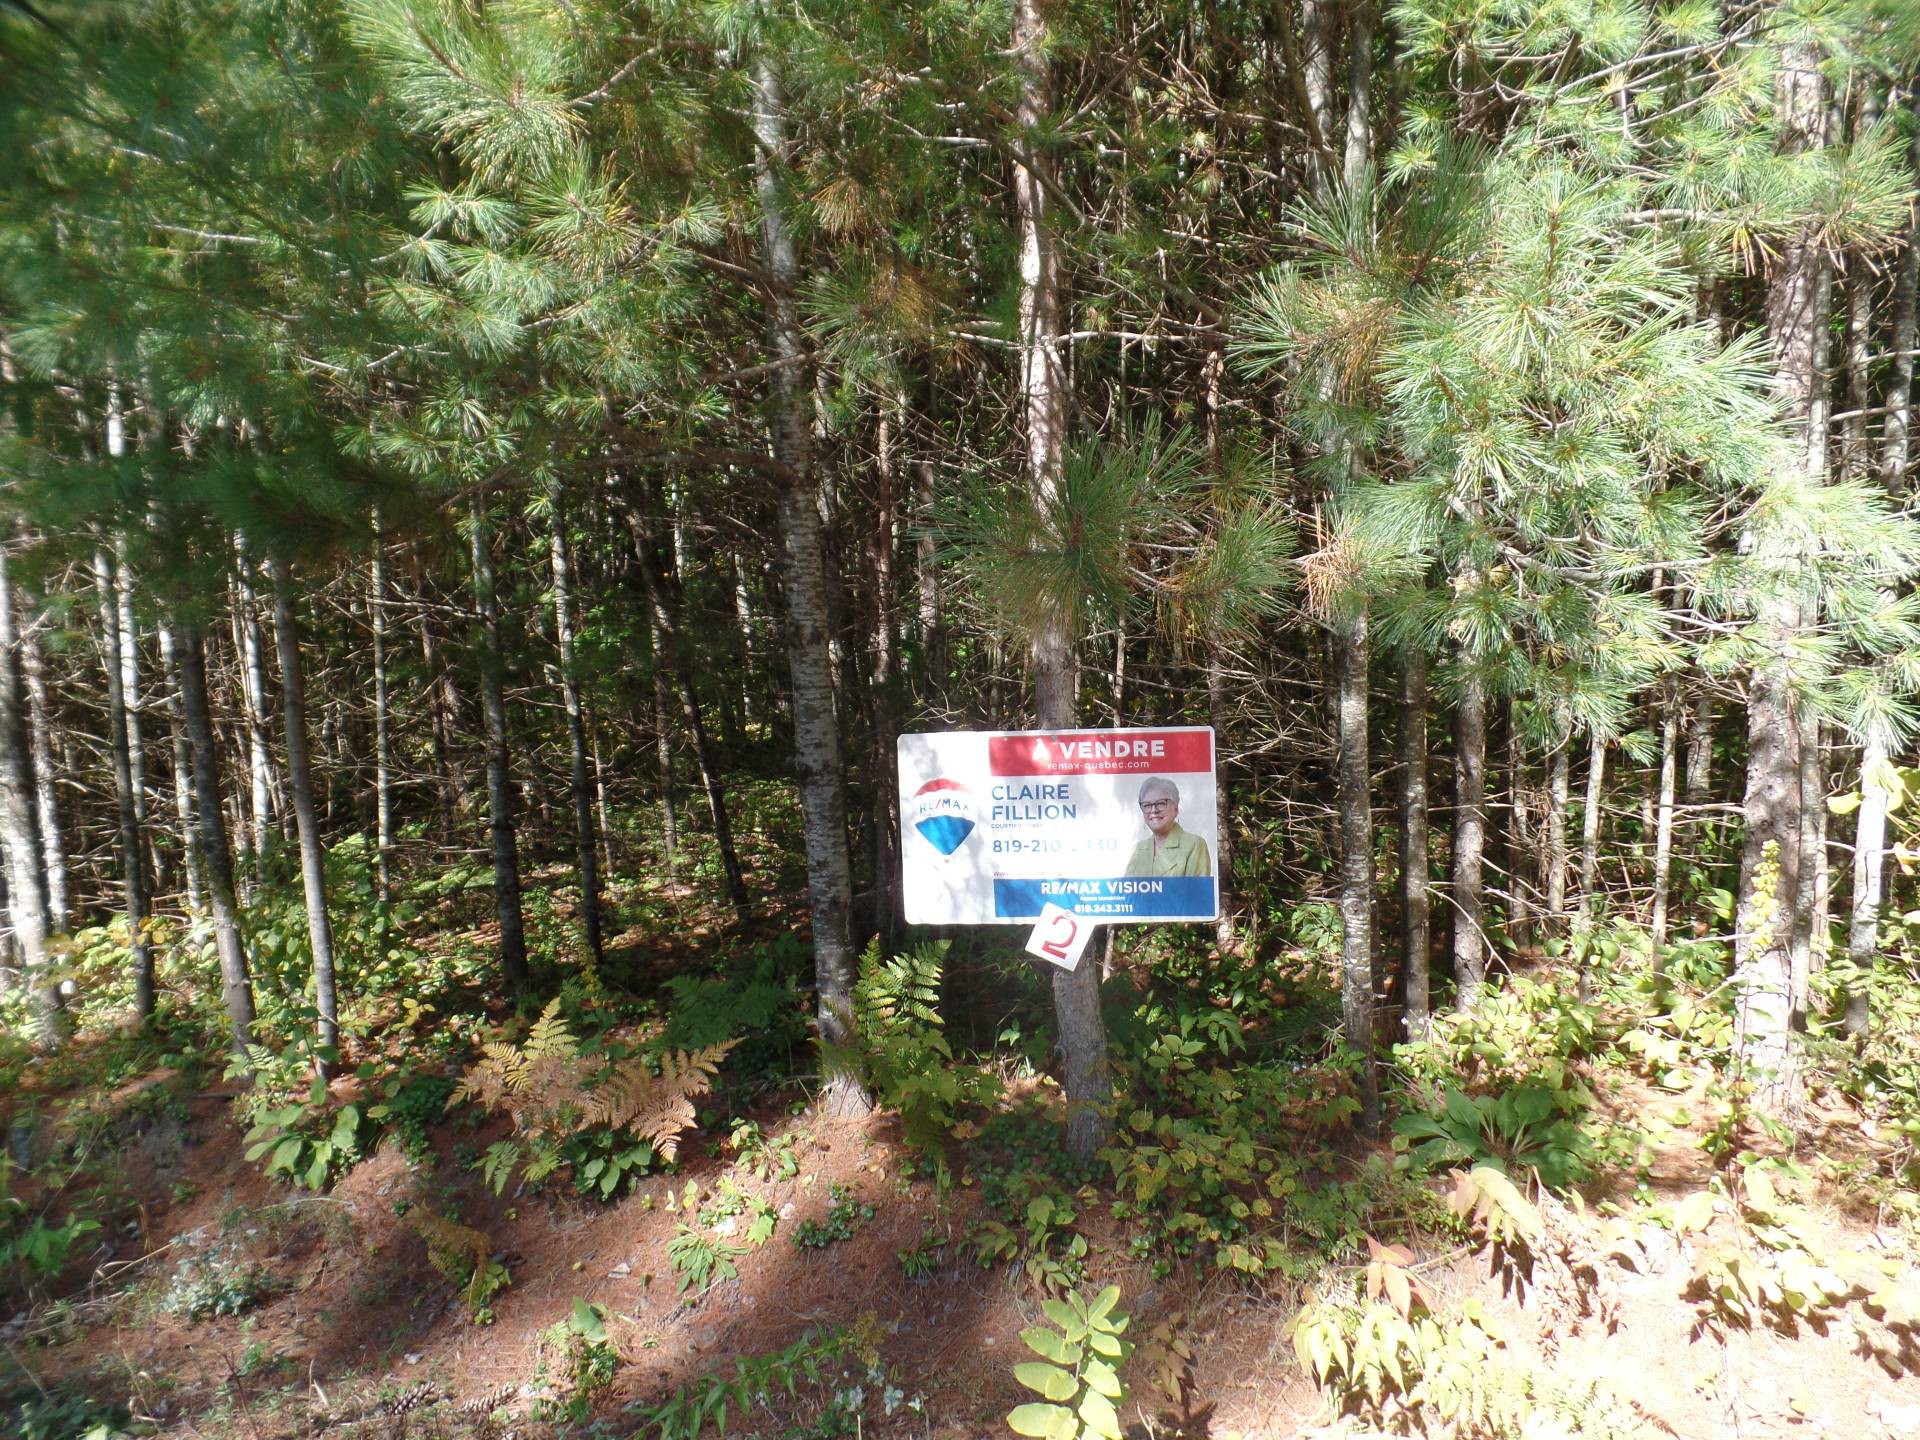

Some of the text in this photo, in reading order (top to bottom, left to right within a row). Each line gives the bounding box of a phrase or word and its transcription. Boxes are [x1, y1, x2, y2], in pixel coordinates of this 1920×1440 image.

[1060, 740, 1165, 759] VENDRE
[1047, 760, 1150, 770] remax-quebec.com
[991, 784, 1070, 801] CLAIRE
[991, 804, 1077, 820] FILLION
[1041, 880, 1163, 895] RE/MAX VISION
[1074, 903, 1133, 913] 819.243.3111
[1041, 915, 1077, 960] 2
